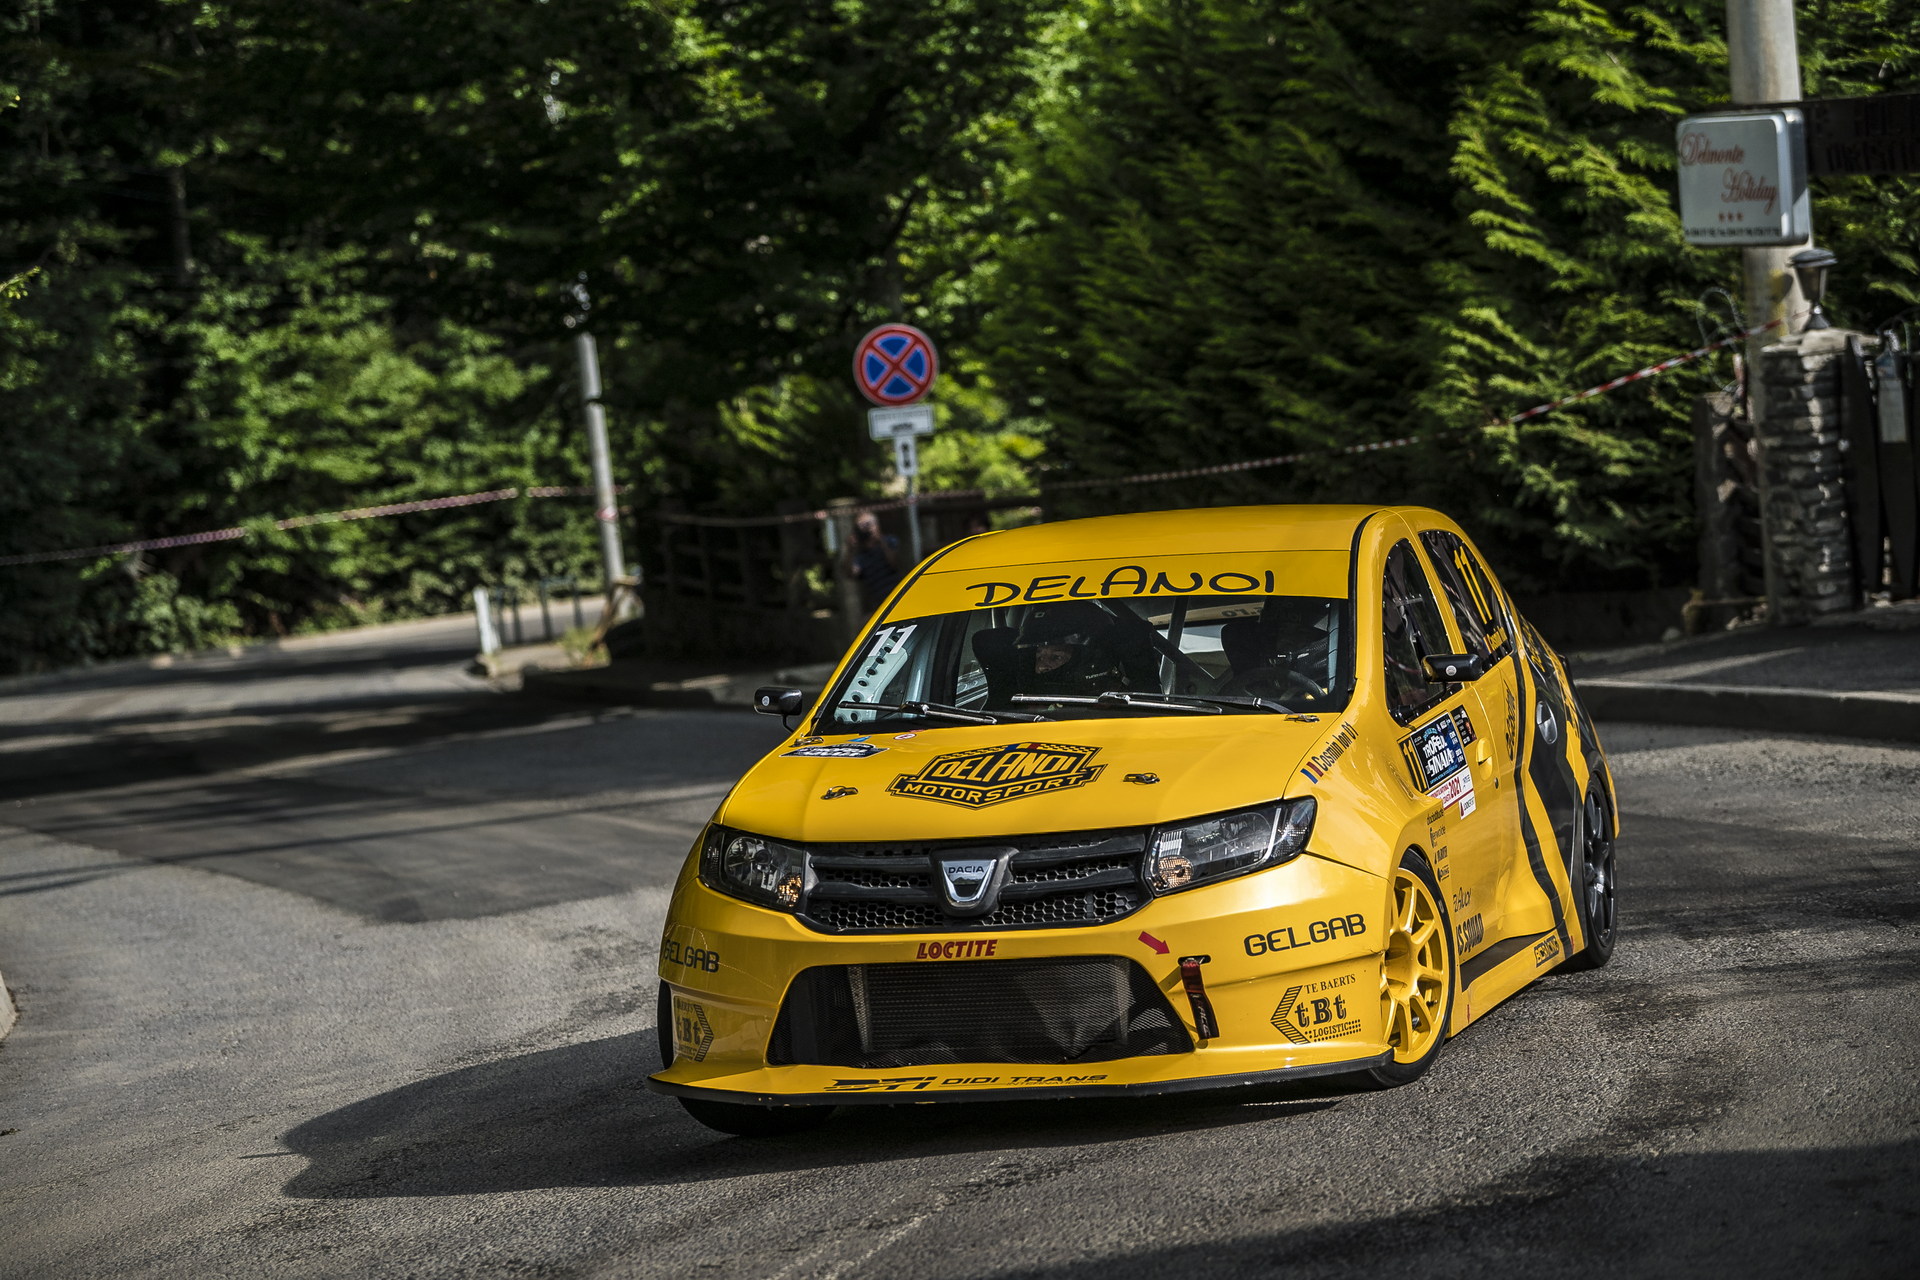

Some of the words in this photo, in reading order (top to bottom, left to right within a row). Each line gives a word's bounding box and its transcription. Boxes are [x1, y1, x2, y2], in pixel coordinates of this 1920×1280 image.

[1680, 133, 1744, 166] Delmonte
[1721, 168, 1777, 215] Holiday
[966, 565, 1274, 607] DELANOI
[1454, 546, 1493, 624] 11
[868, 624, 918, 657] 11
[1311, 741, 1345, 771] Cosmin
[1332, 731, 1353, 750] Ion
[1427, 748, 1455, 777] SINAIA
[936, 753, 1073, 783] DELANOI
[903, 774, 1085, 803] MOTORSPORT
[1449, 776, 1462, 798] 2021
[948, 866, 985, 874] DACIA
[916, 939, 998, 960] LOCTITE
[1243, 913, 1367, 957] GELGAB
[663, 938, 720, 973] GELGAB
[1304, 982, 1318, 994] TE
[1320, 973, 1356, 992] BAERTS
[1294, 994, 1347, 1029] tBt
[1313, 1021, 1350, 1038] LOGISTIC
[941, 1076, 1000, 1085] DIDI
[1010, 1074, 1108, 1083] TRANS
